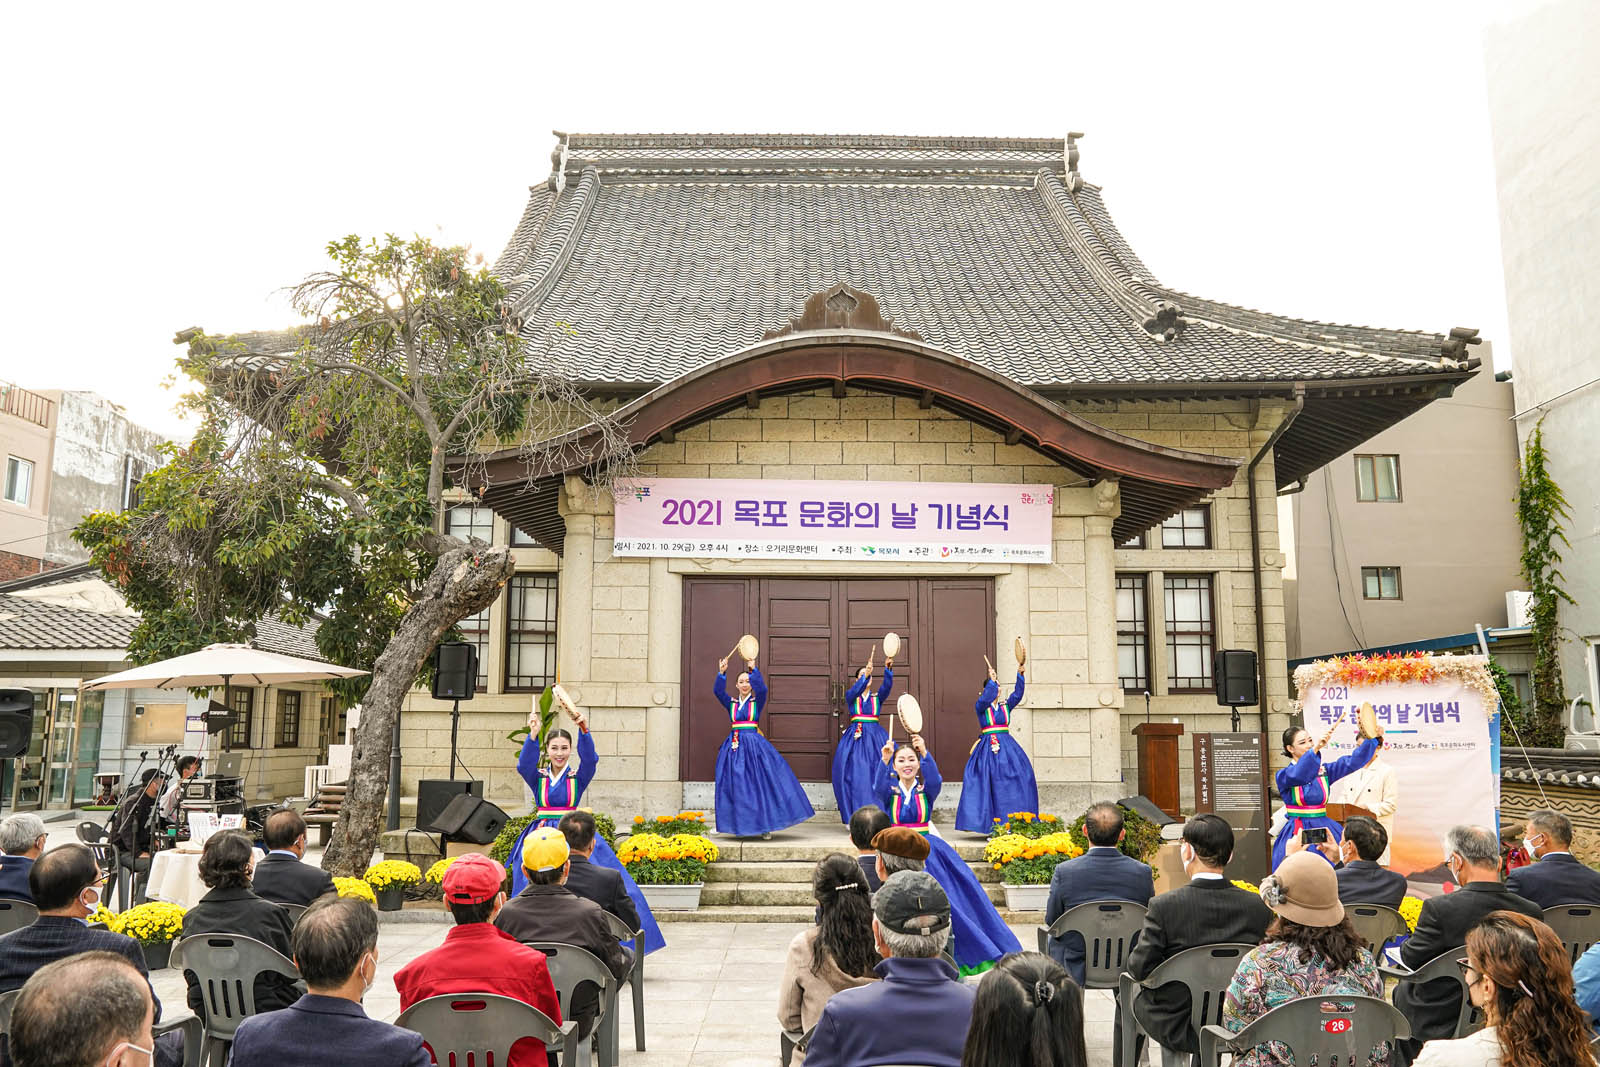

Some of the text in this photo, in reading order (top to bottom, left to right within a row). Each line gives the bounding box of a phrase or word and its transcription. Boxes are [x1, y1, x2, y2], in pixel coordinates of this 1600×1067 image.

[662, 499, 1009, 531] 2021 목포 문화의 날 기념식
[699, 544, 714, 552] 오후
[716, 544, 728, 553] 4시
[766, 544, 818, 554] 오거리문화센터
[1320, 686, 1348, 700] 2021
[1320, 705, 1345, 725] 목포
[1396, 703, 1411, 724] 날
[1415, 701, 1461, 723] 기념식
[1332, 1020, 1345, 1032] 26
